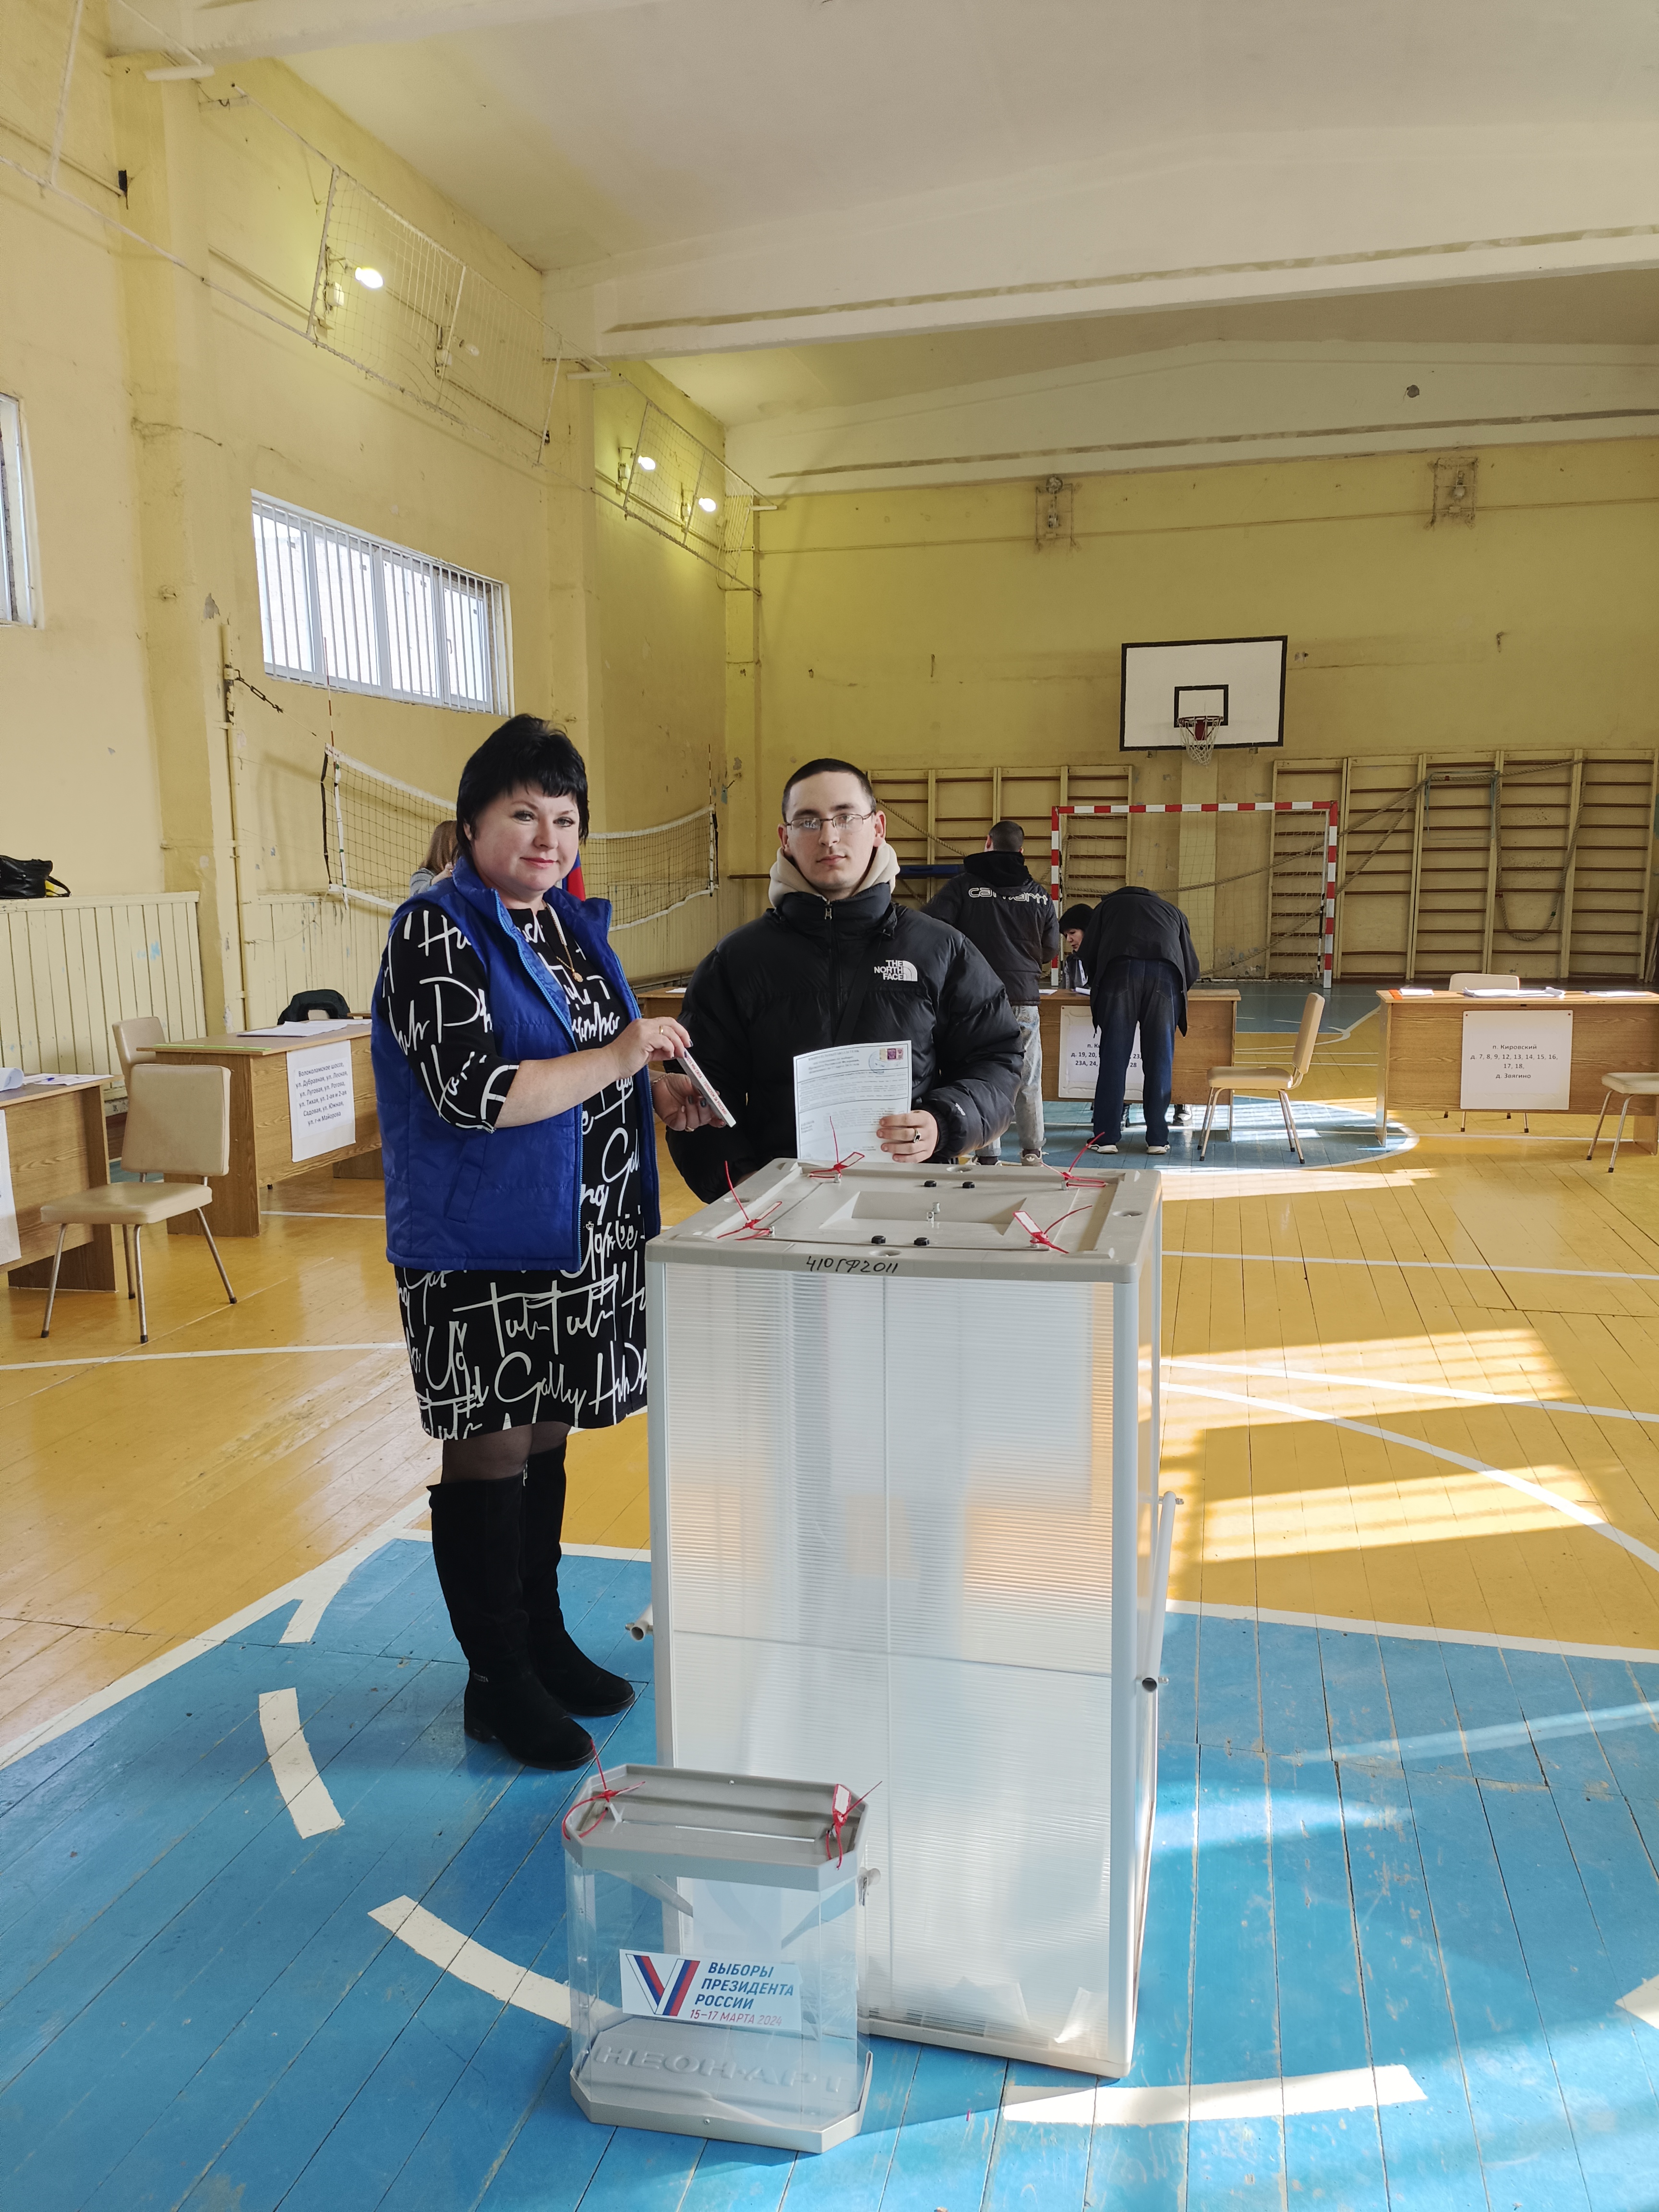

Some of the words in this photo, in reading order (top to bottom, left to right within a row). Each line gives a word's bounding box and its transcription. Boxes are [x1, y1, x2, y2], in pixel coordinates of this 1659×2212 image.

[299, 1065, 330, 1076] Волоколамское
[303, 1076, 325, 1087] Дубравная,
[307, 1086, 324, 1096] Луговая,
[303, 1108, 322, 1116] Садовая,
[329, 1101, 344, 1109] Южная,
[322, 1112, 341, 1121] Майорова
[708, 1962, 774, 1978] ВЫБОРЫ
[701, 1978, 794, 1996] ПРЕЗИДЕНТА
[695, 1994, 754, 2009] РОССИИ
[720, 2012, 755, 2024] МАРТА
[757, 2015, 782, 2026] 2024
